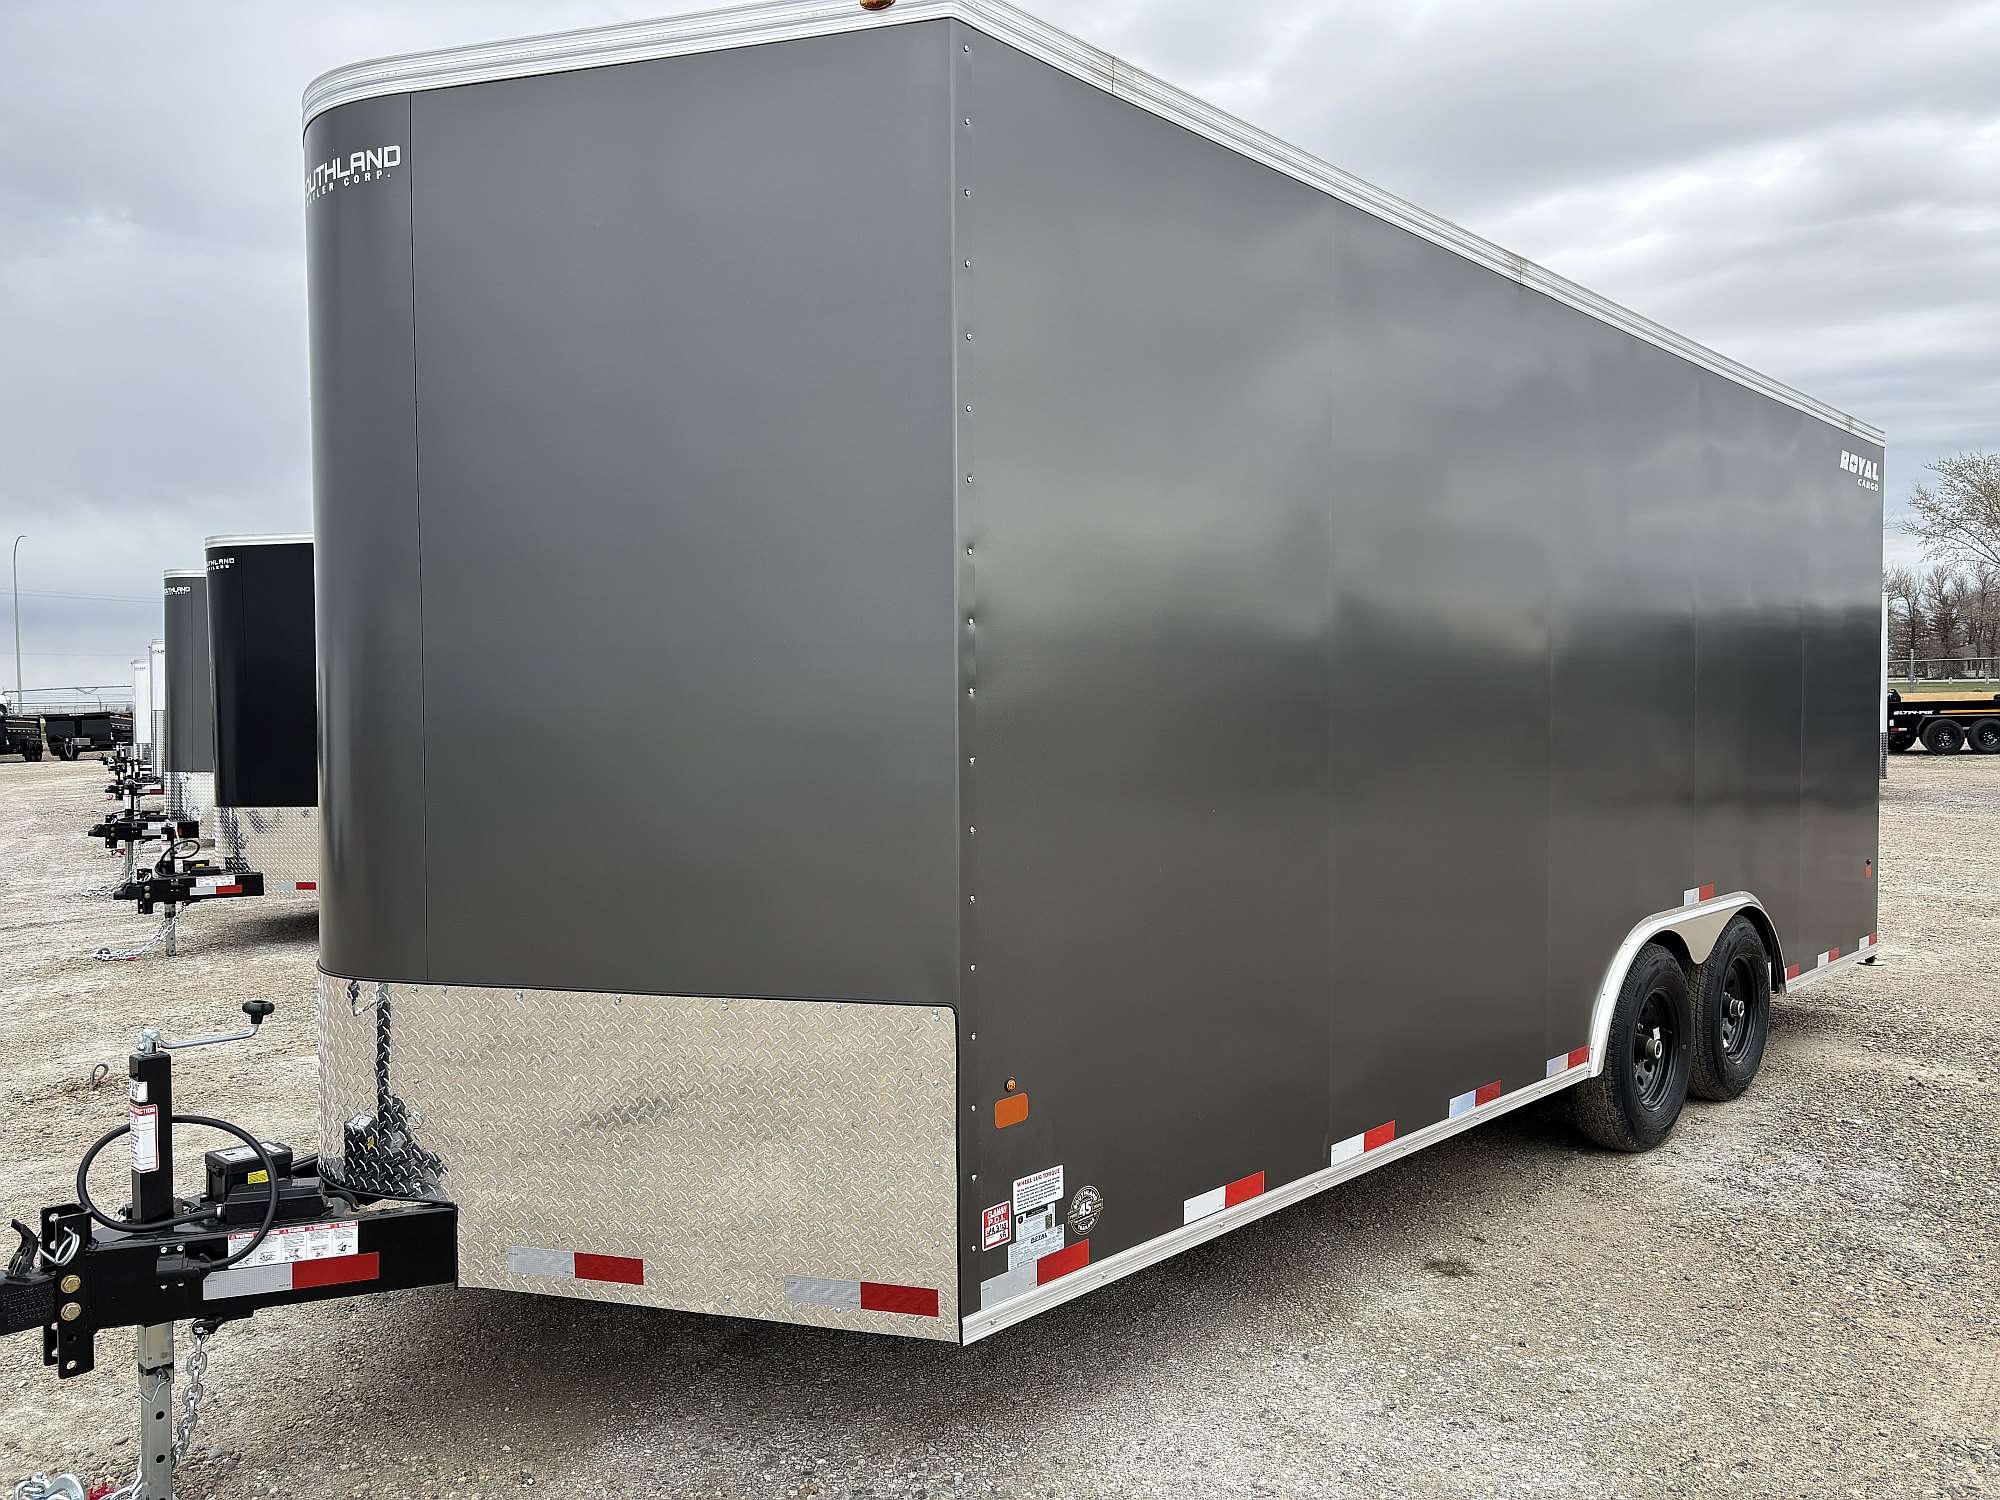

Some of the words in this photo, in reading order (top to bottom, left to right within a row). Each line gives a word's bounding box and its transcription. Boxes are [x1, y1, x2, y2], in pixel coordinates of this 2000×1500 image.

[305, 145, 401, 200] OUTHLAND
[343, 170, 391, 187] CORP.
[1840, 449, 1879, 482] ROYAL
[1857, 478, 1879, 492] CARGO
